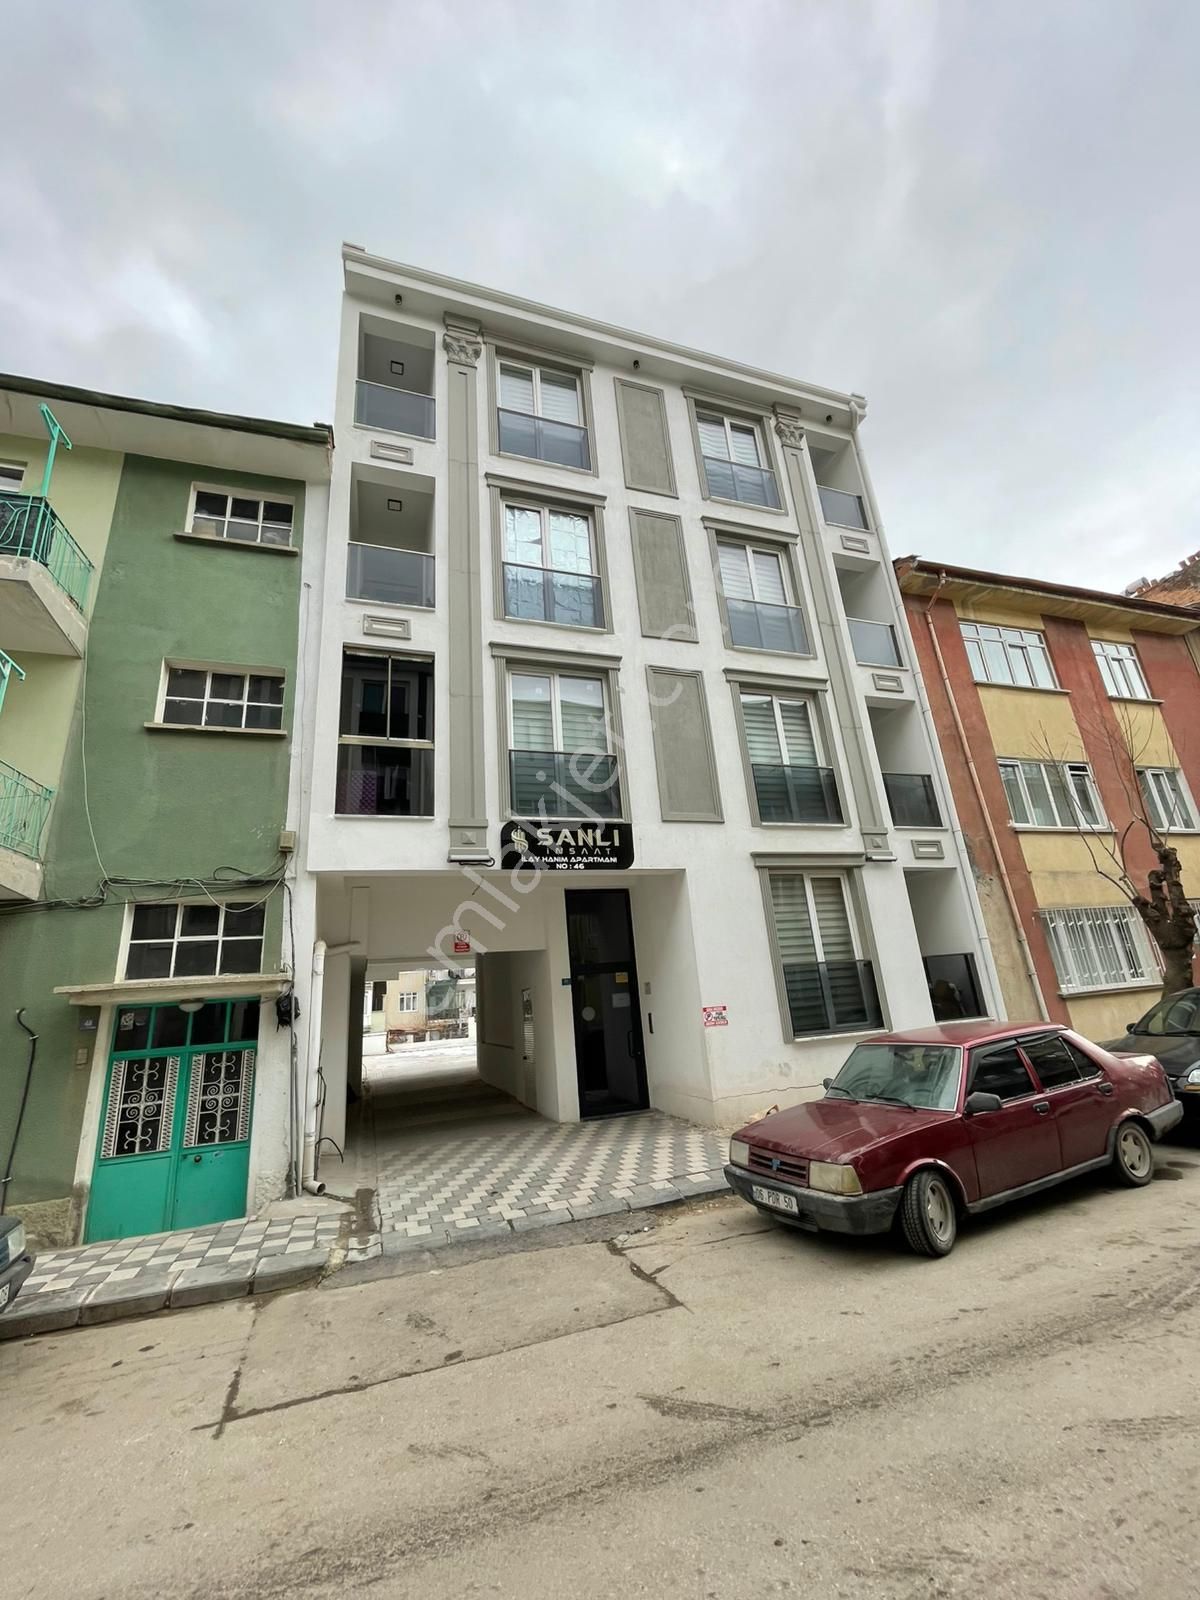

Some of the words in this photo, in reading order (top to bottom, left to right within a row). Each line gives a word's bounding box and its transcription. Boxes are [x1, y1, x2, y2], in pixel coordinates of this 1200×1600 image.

[542, 856, 568, 864] HANIM
[570, 856, 618, 864] APARTMANI
[573, 862, 585, 870] 46
